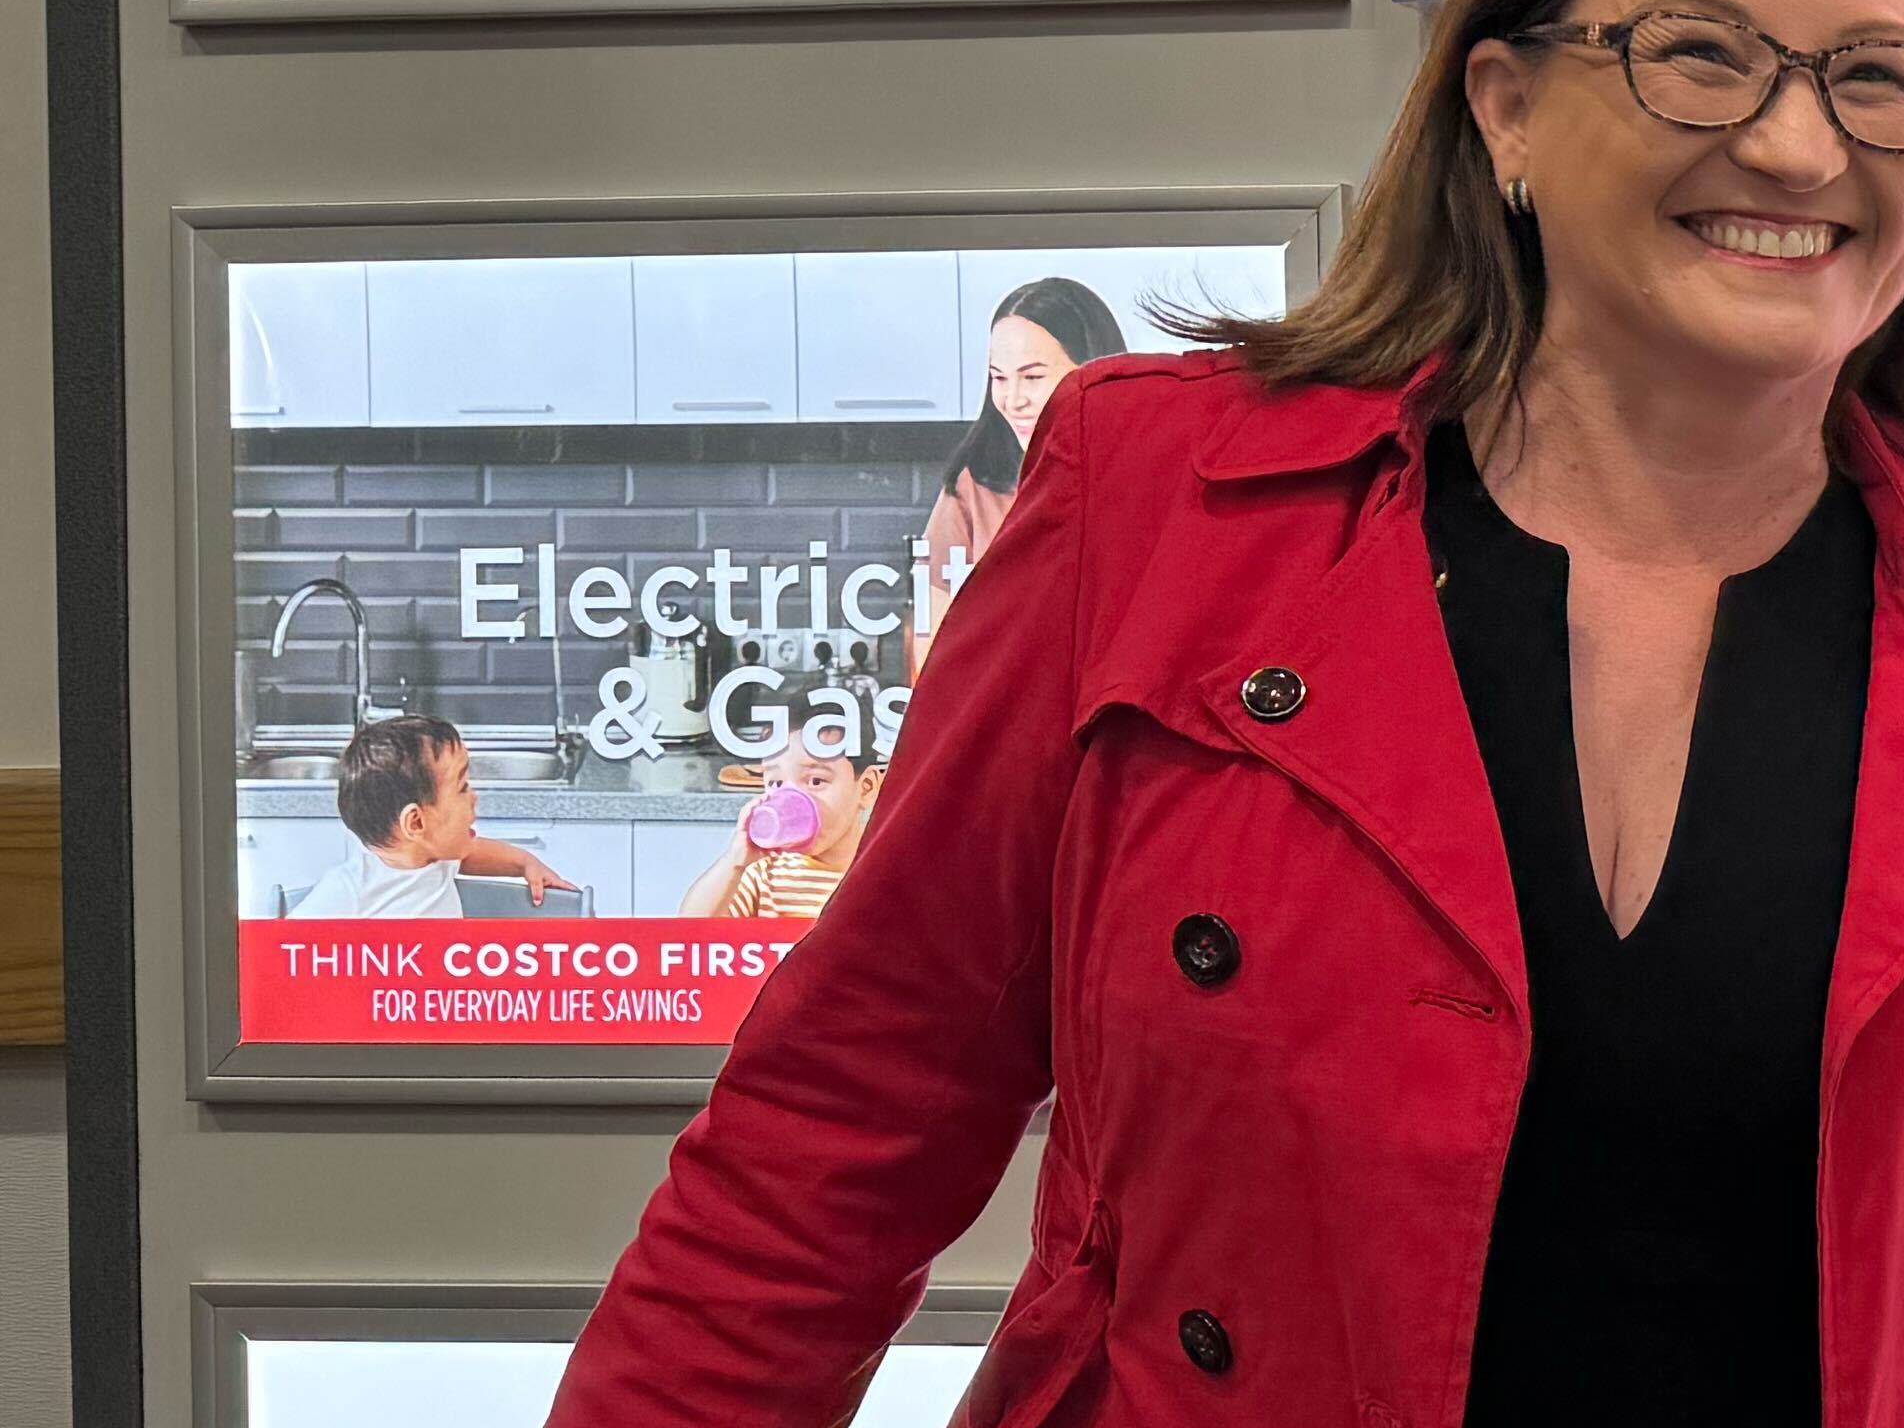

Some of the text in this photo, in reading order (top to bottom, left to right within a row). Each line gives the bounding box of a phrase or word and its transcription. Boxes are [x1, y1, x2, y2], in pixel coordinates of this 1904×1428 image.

[588, 669, 663, 761] &
[281, 942, 422, 978] THINK
[443, 942, 638, 978] COSTCO
[372, 988, 701, 1023] FOR EVERYDAY LIFE SAVINGS
